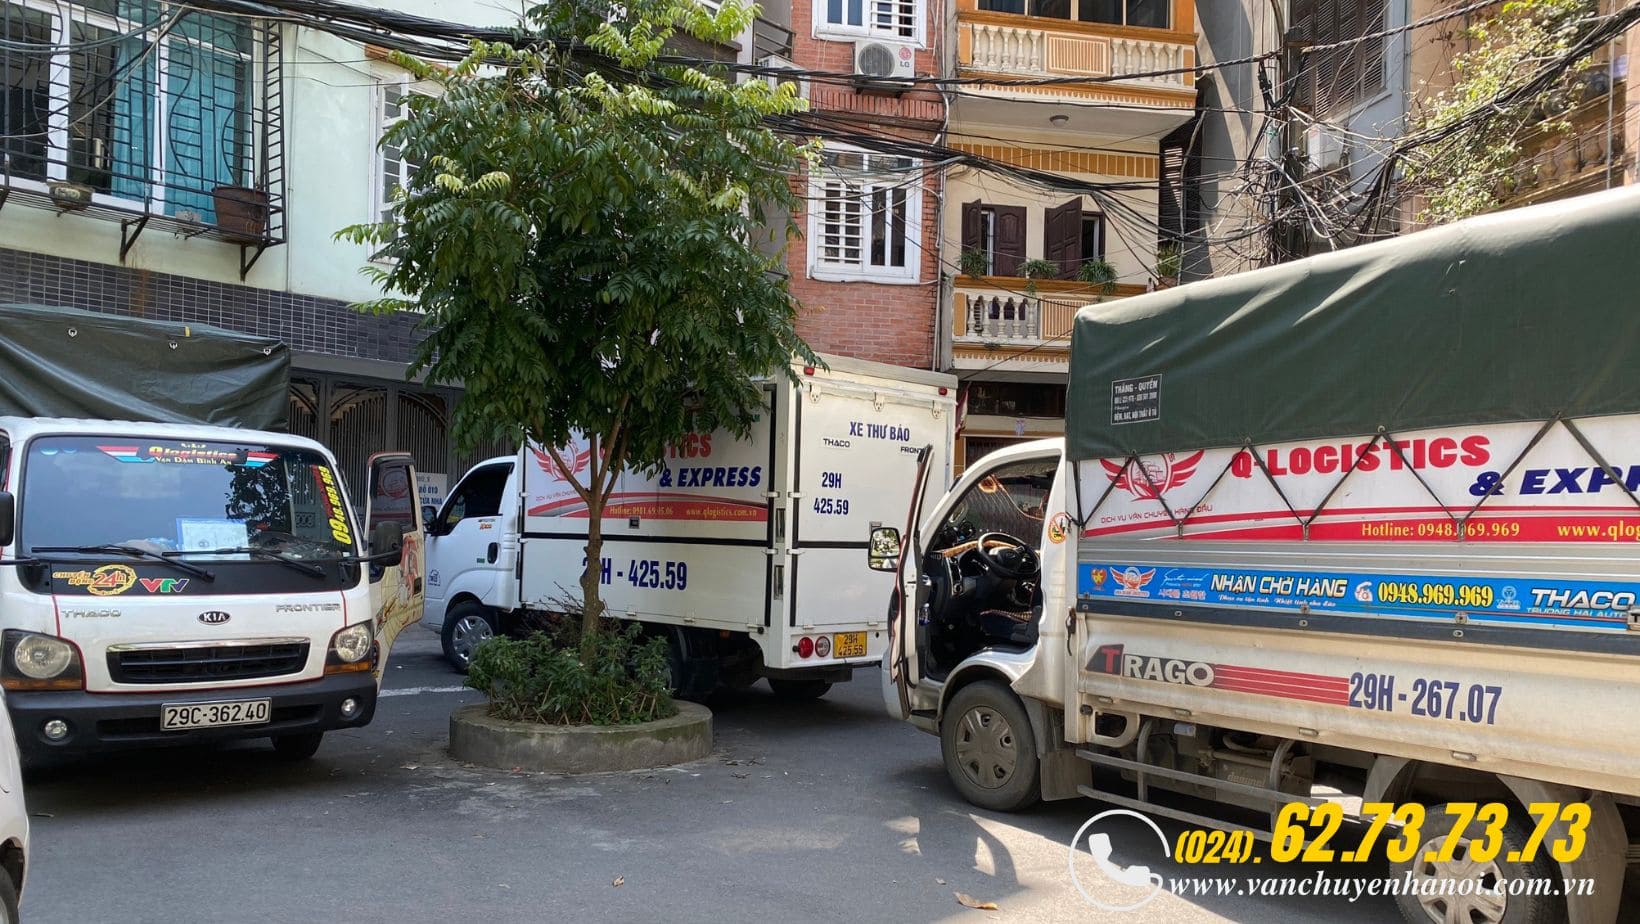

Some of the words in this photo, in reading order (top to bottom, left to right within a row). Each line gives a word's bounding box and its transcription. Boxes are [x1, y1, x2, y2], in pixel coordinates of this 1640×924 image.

[850, 421, 864, 437] XE
[867, 423, 888, 440] THƯ
[823, 438, 851, 448] THACO
[1231, 435, 1490, 478] Q-LOGISTICS
[659, 467, 673, 487] &
[677, 466, 762, 487] EXPRESS
[822, 472, 842, 488] 29H
[1469, 471, 1505, 496] &
[814, 498, 849, 515] 425.59
[1362, 523, 1414, 536] Hotline:
[94, 570, 127, 588] 24h
[628, 560, 687, 590] 425.59
[139, 578, 190, 593] VTV
[1211, 573, 1257, 594] NHẬN
[1260, 576, 1294, 595] CHỞ
[1296, 578, 1348, 597] HÀNG
[1378, 582, 1493, 607] 0948.969.969
[276, 603, 341, 612] FRONTIER
[1531, 588, 1636, 611] THACO
[62, 609, 121, 618] THACO
[203, 612, 226, 622] KIA
[844, 634, 858, 644] 29H
[1102, 648, 1215, 687] TRAGO
[1349, 672, 1395, 711] 29H
[1411, 678, 1503, 725] 267.07
[167, 703, 266, 726] 29C-362.40
